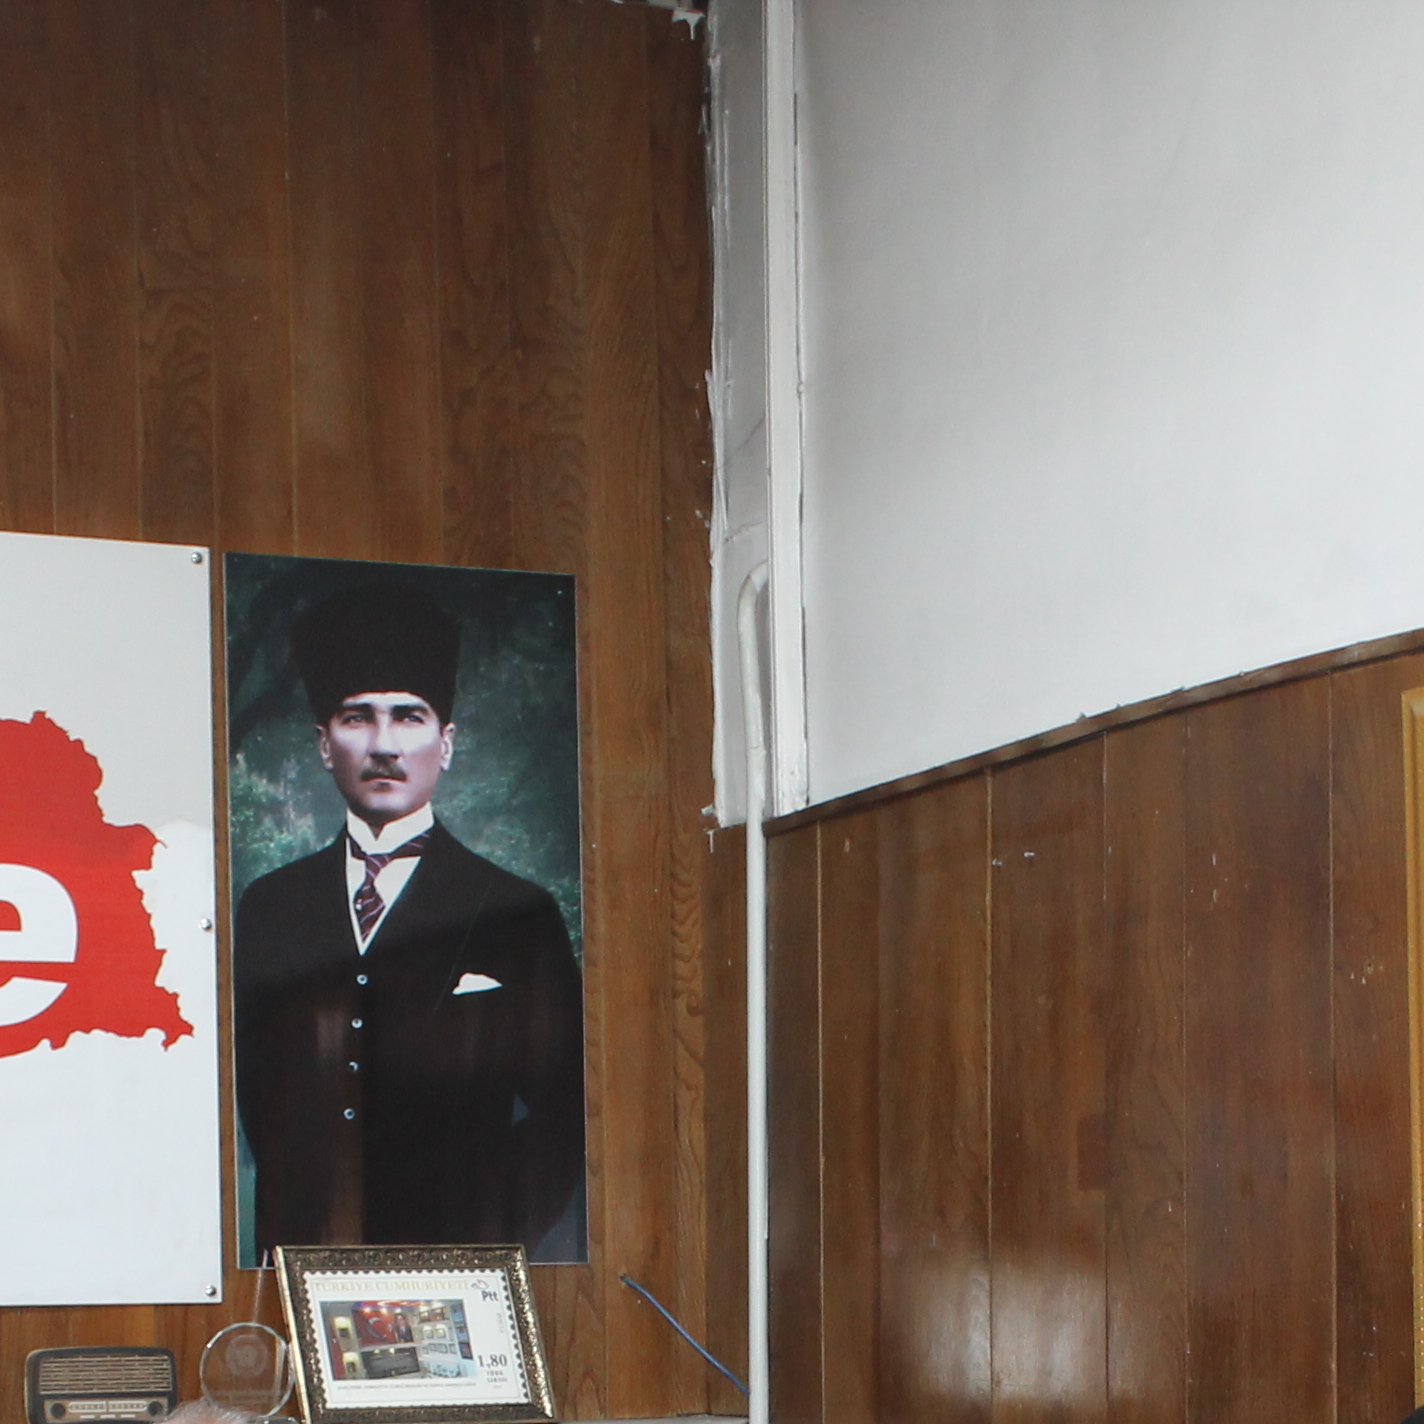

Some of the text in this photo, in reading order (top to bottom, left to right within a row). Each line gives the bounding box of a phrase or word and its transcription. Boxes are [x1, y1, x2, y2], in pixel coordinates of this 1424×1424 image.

[314, 1279, 371, 1292] TÜRKİYE
[482, 1290, 499, 1302] Ptt
[478, 1354, 508, 1369] 1,80
